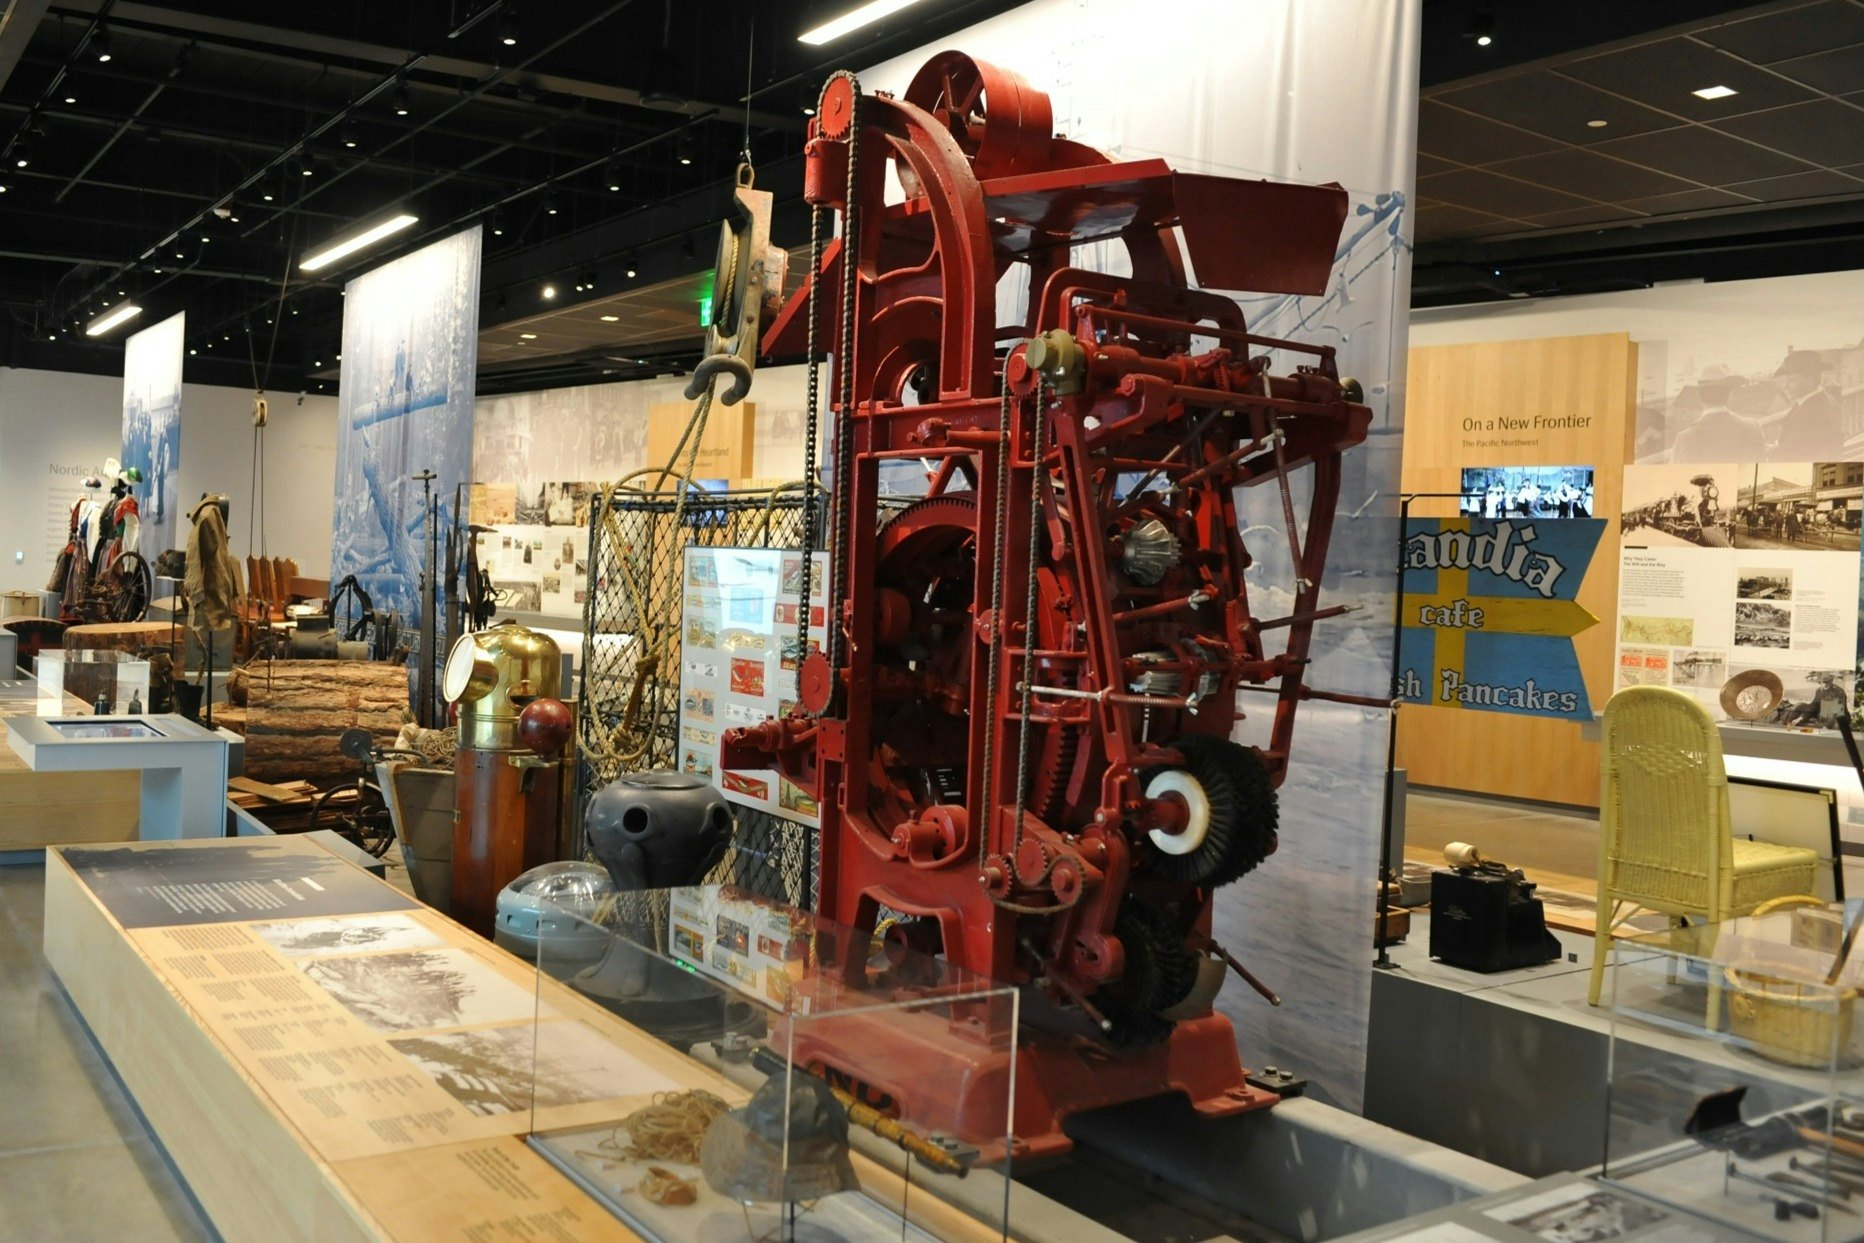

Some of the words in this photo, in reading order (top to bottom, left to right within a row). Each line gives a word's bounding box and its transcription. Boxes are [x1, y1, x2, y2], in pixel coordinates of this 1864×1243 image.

[1462, 417, 1482, 432] On
[1486, 420, 1494, 431] a
[1498, 416, 1530, 430] New
[1533, 414, 1592, 429] Frontier
[1462, 440, 1475, 448] The
[1476, 439, 1499, 448] Pacific
[1501, 438, 1539, 447] Northwest
[49, 464, 89, 477] Nordic
[1397, 520, 1567, 599] andia
[1419, 598, 1485, 629] cafe
[1440, 667, 1579, 713] Pancakes
